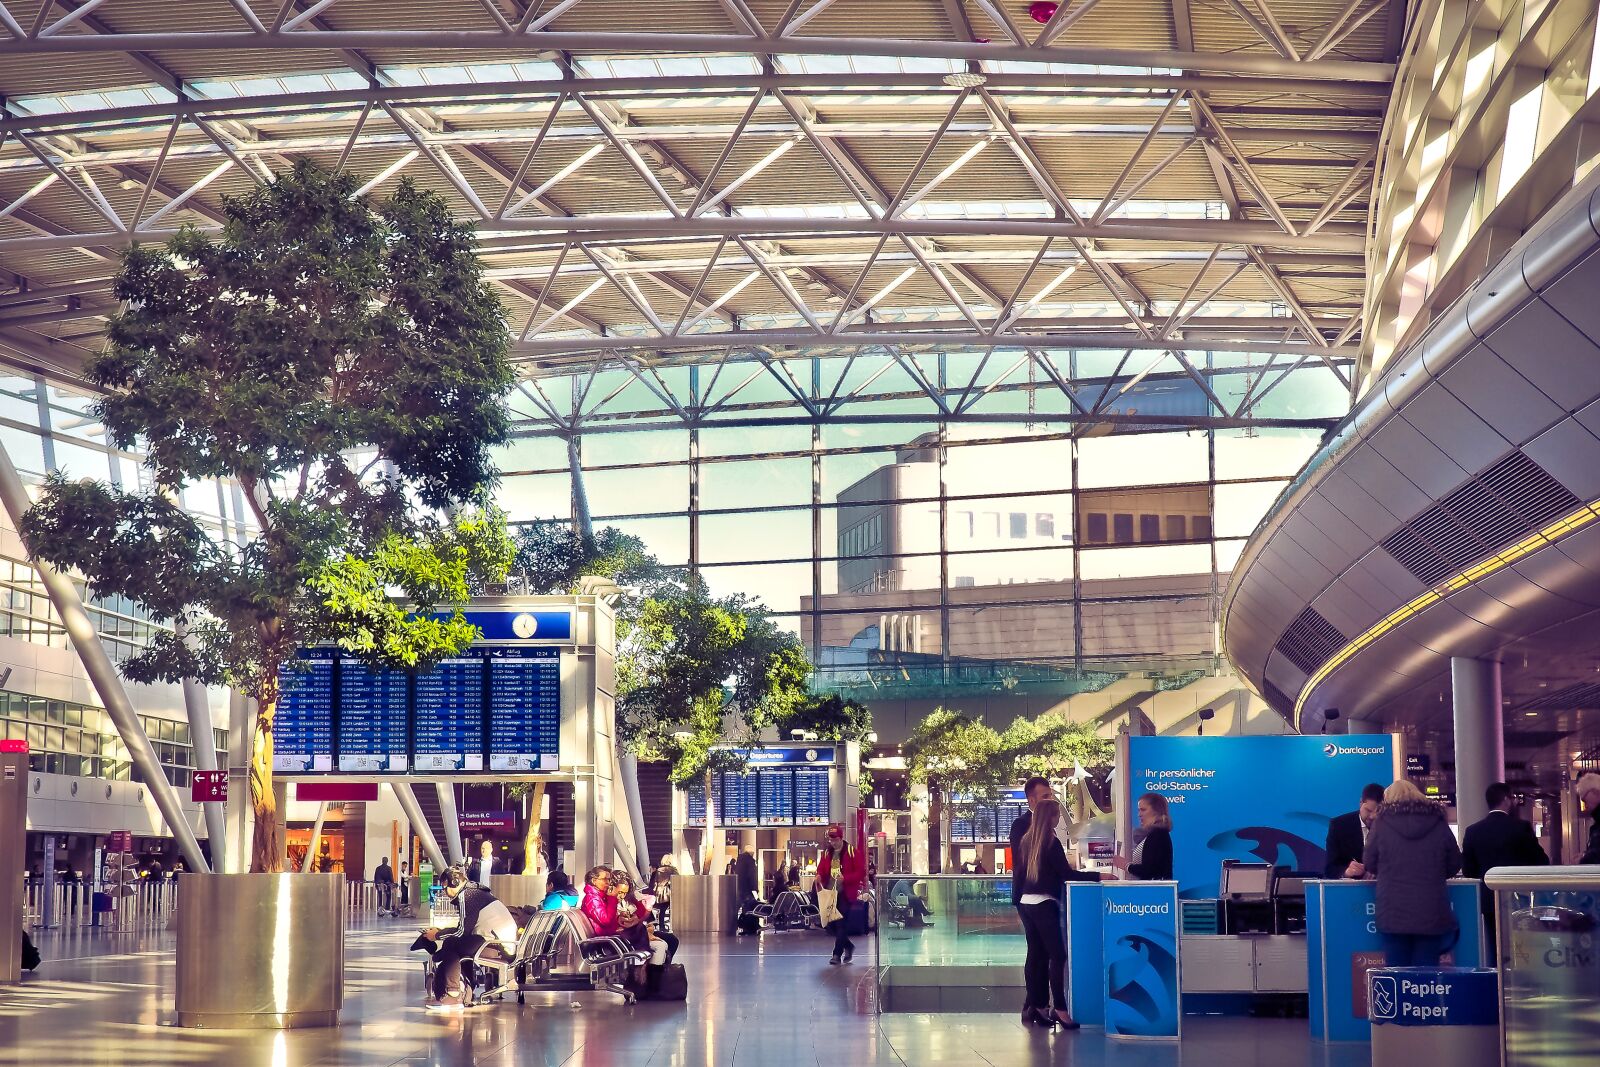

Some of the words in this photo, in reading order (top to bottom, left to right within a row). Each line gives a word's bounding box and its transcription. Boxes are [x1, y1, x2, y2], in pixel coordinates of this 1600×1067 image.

[1339, 746, 1385, 756] barclaycard
[1145, 769, 1158, 778] Ihr
[1159, 768, 1216, 780] persönlicher
[1145, 781, 1201, 791] Gold-Status
[1112, 902, 1169, 916] barclaycard
[1402, 979, 1452, 998] Papier
[1402, 1001, 1449, 1020] Paper
